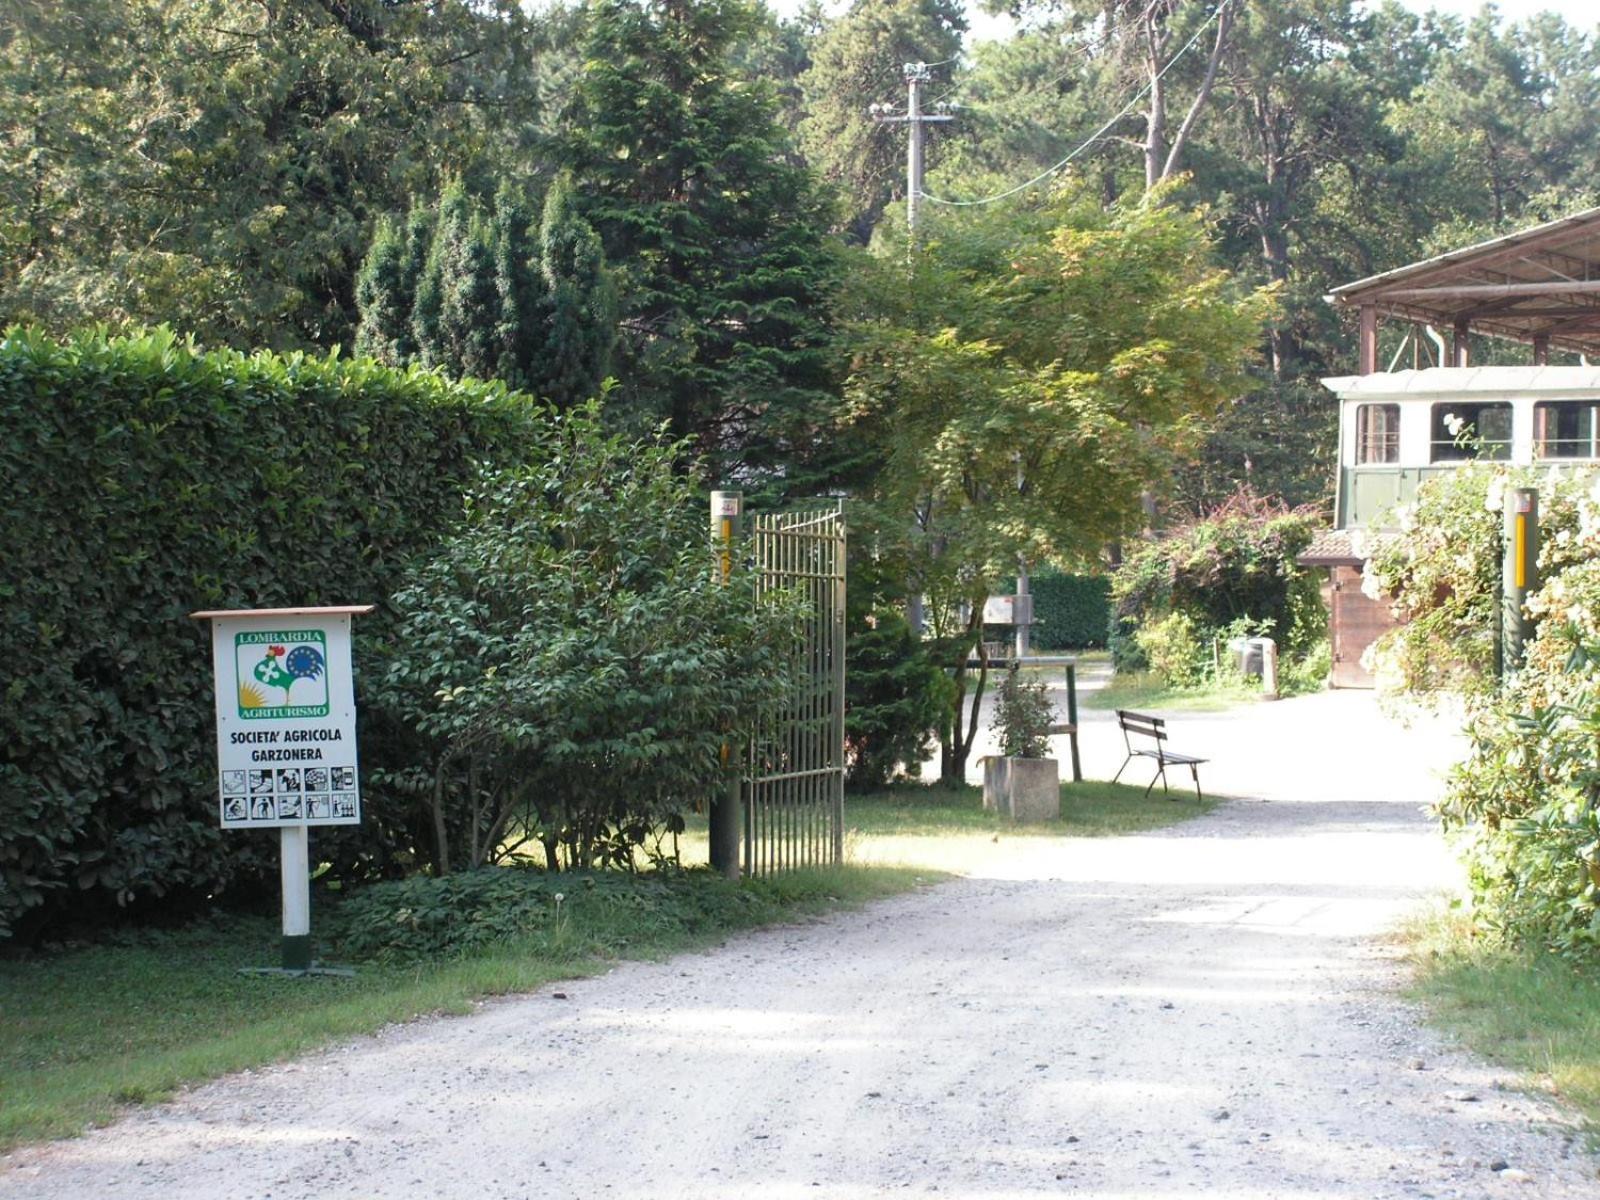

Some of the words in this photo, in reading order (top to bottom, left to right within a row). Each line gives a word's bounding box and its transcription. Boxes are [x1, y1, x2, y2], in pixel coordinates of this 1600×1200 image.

[239, 631, 322, 643] LOMBARDIA
[241, 706, 327, 718] AGRITURISMO
[230, 731, 280, 744] SOCIETA'
[284, 729, 342, 742] AGRICOLA
[252, 748, 323, 762] GARZONERA
